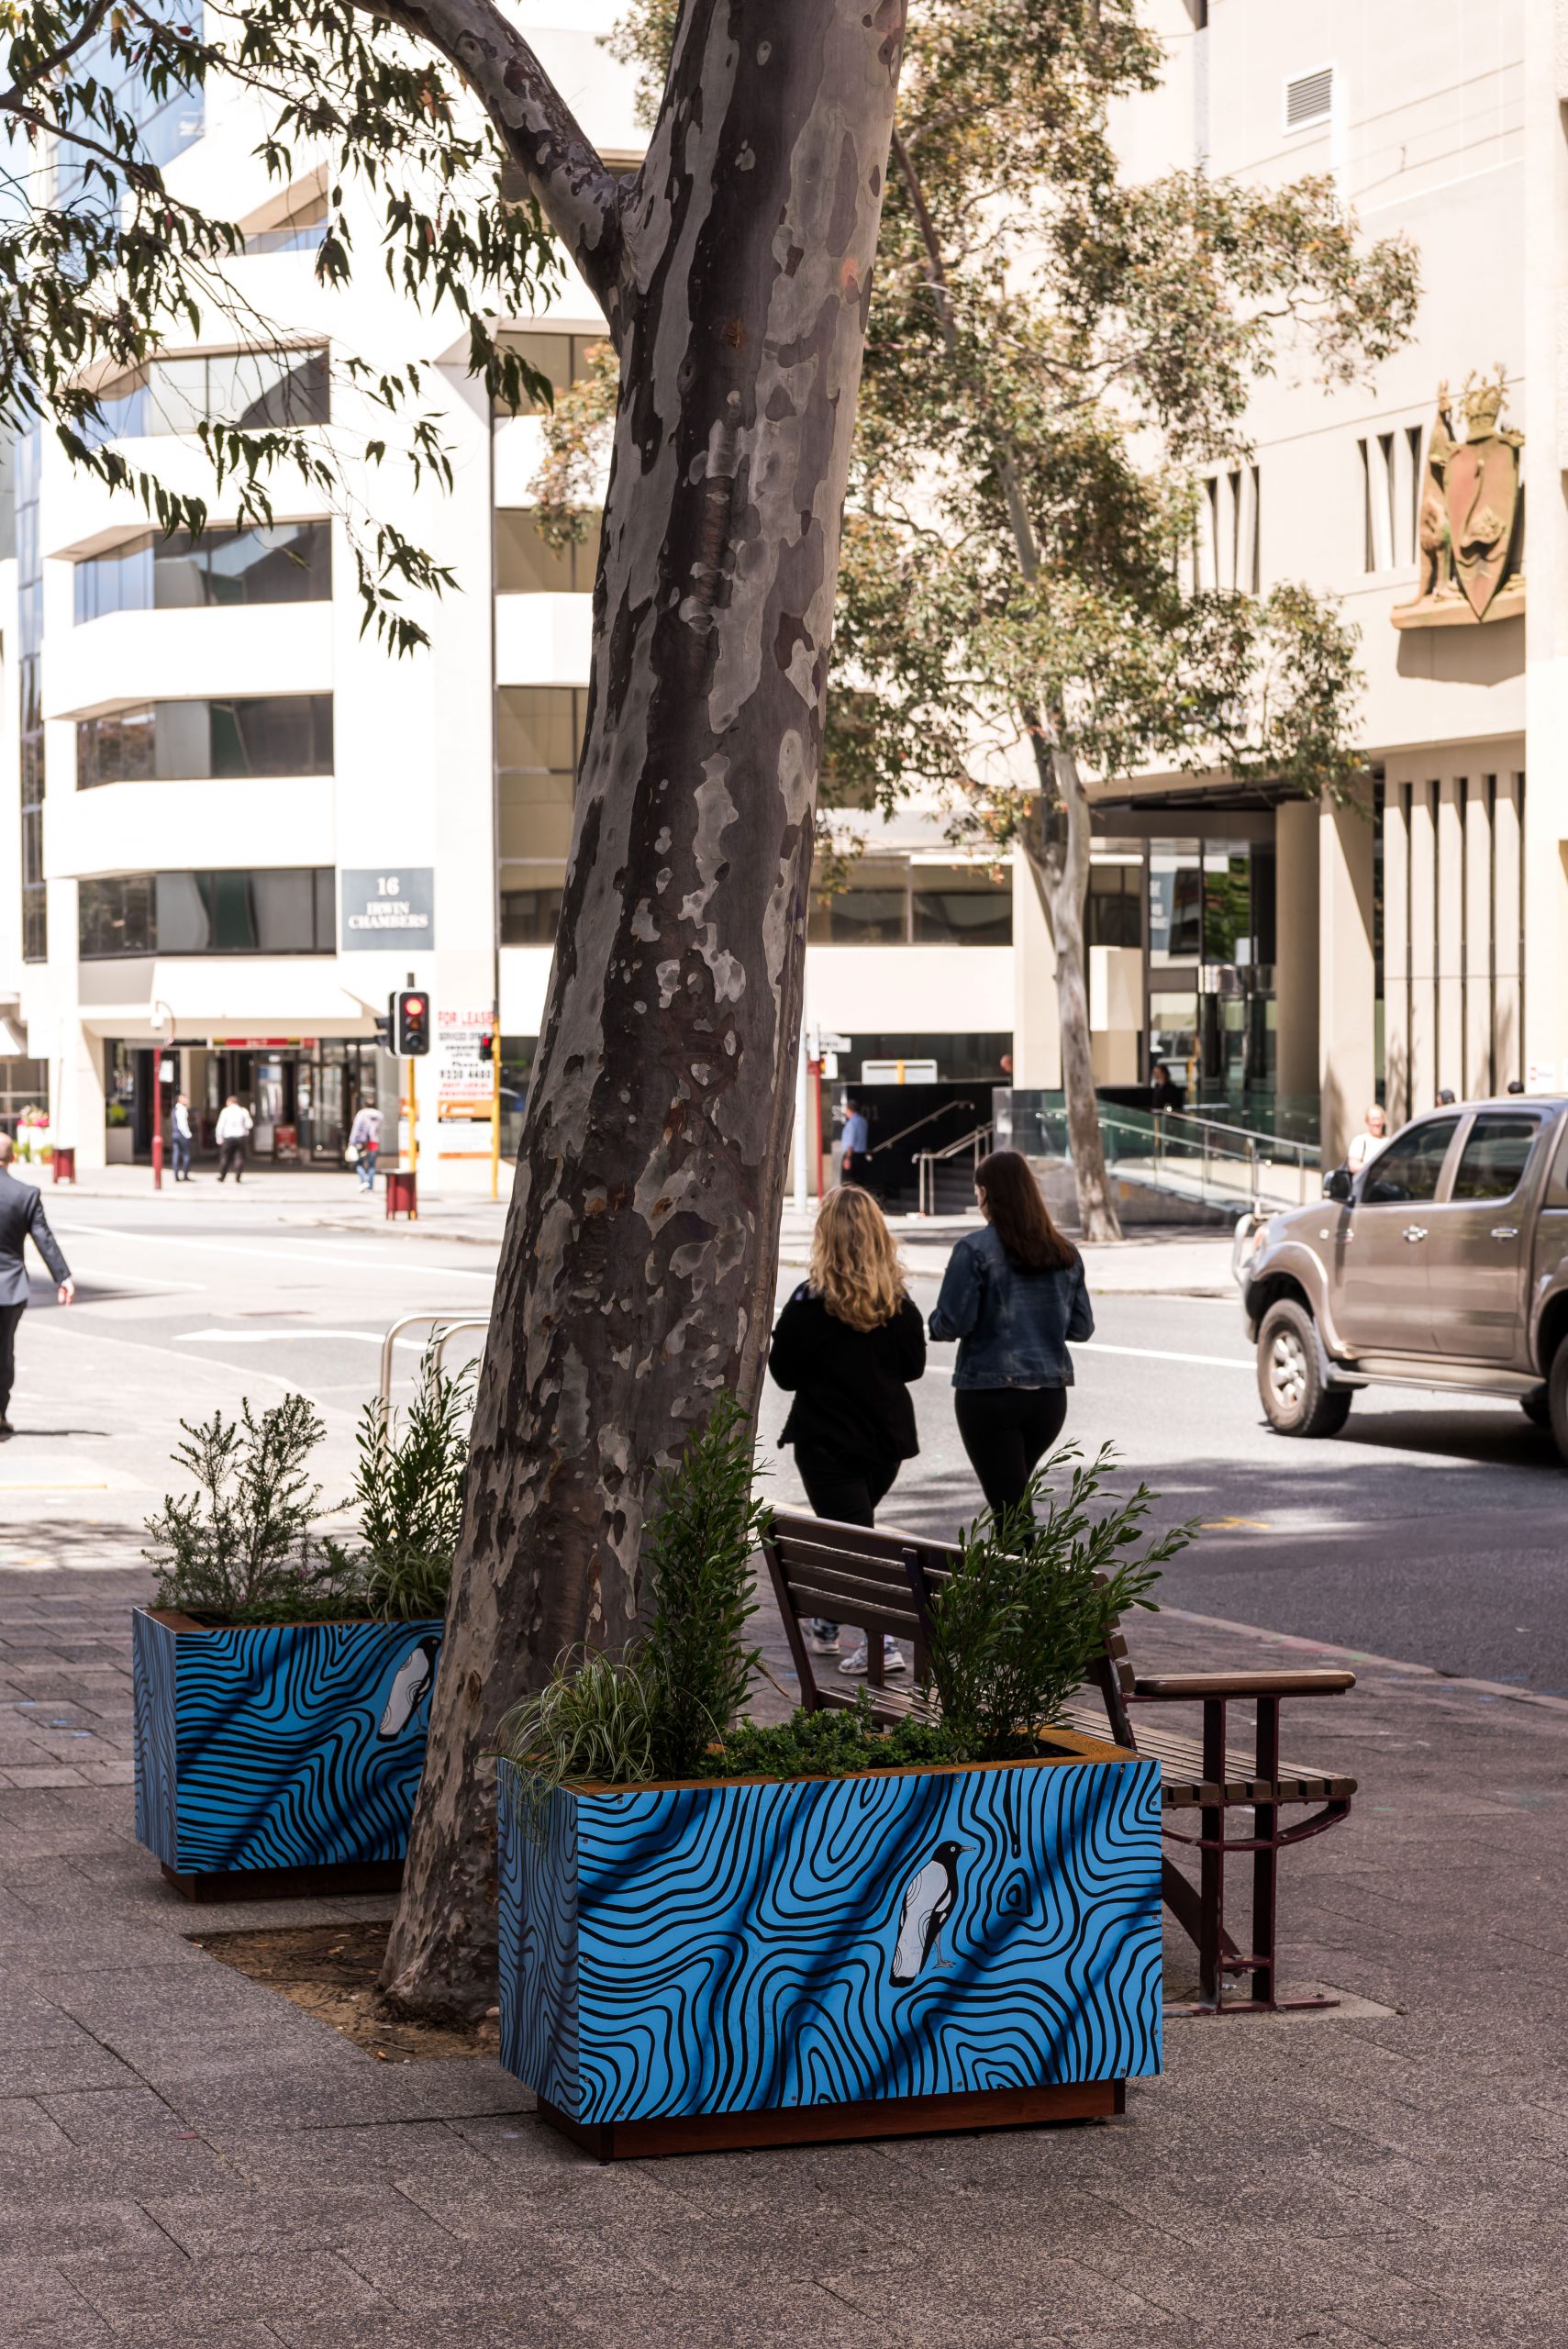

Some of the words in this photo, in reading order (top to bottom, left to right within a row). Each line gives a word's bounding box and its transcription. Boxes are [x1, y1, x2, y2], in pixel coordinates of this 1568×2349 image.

[377, 876, 400, 896] 16
[366, 901, 410, 915] IRWIN
[348, 914, 428, 930] CHAMBERS
[438, 1011, 456, 1025] FOR
